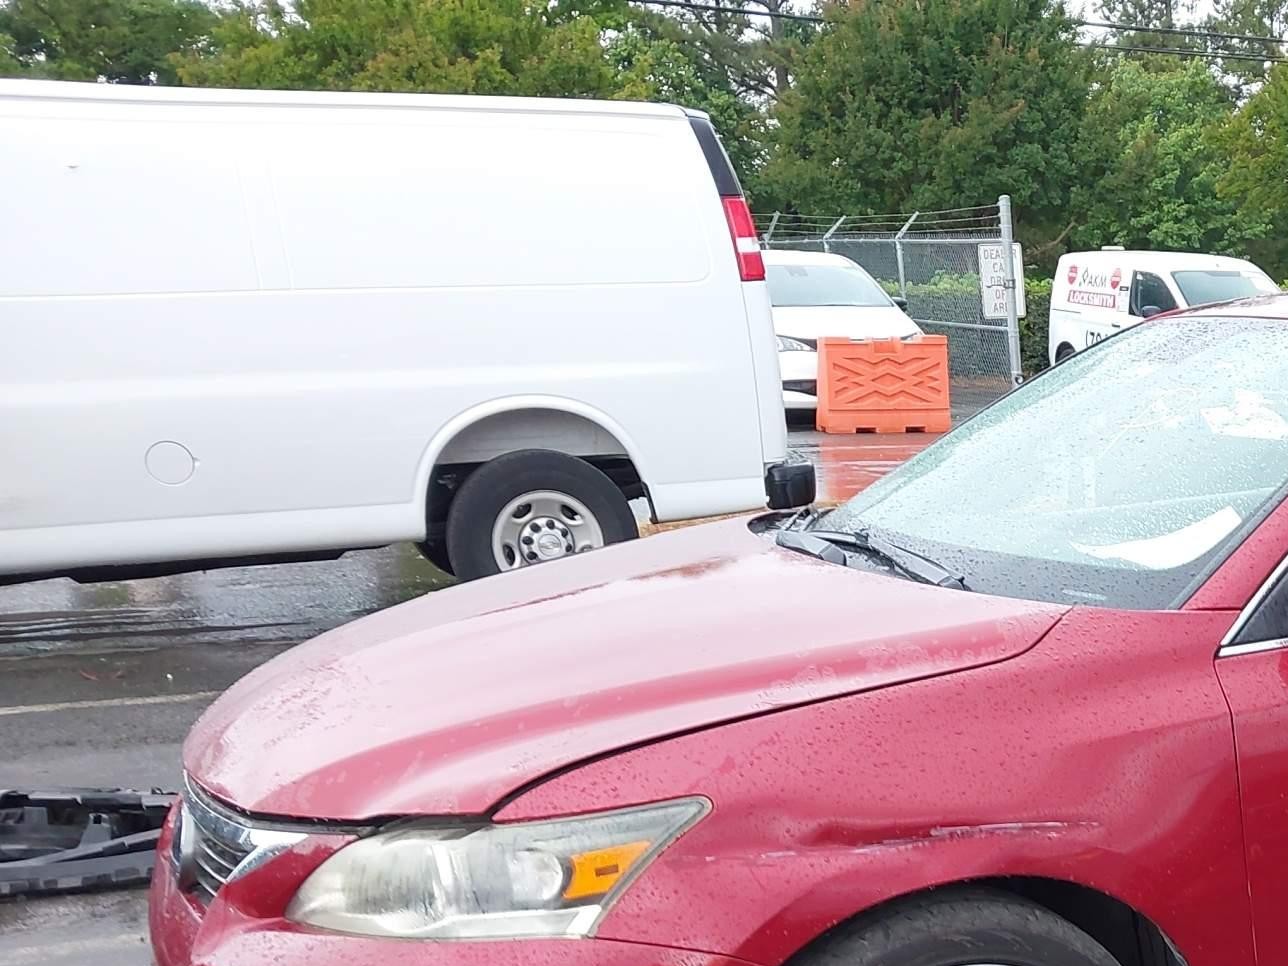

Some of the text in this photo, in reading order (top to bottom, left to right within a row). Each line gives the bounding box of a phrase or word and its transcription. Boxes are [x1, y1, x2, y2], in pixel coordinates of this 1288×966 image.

[983, 249, 1017, 260] DEALR
[1069, 290, 1114, 308] LOCKSMITH
[1085, 329, 1109, 347] (70
